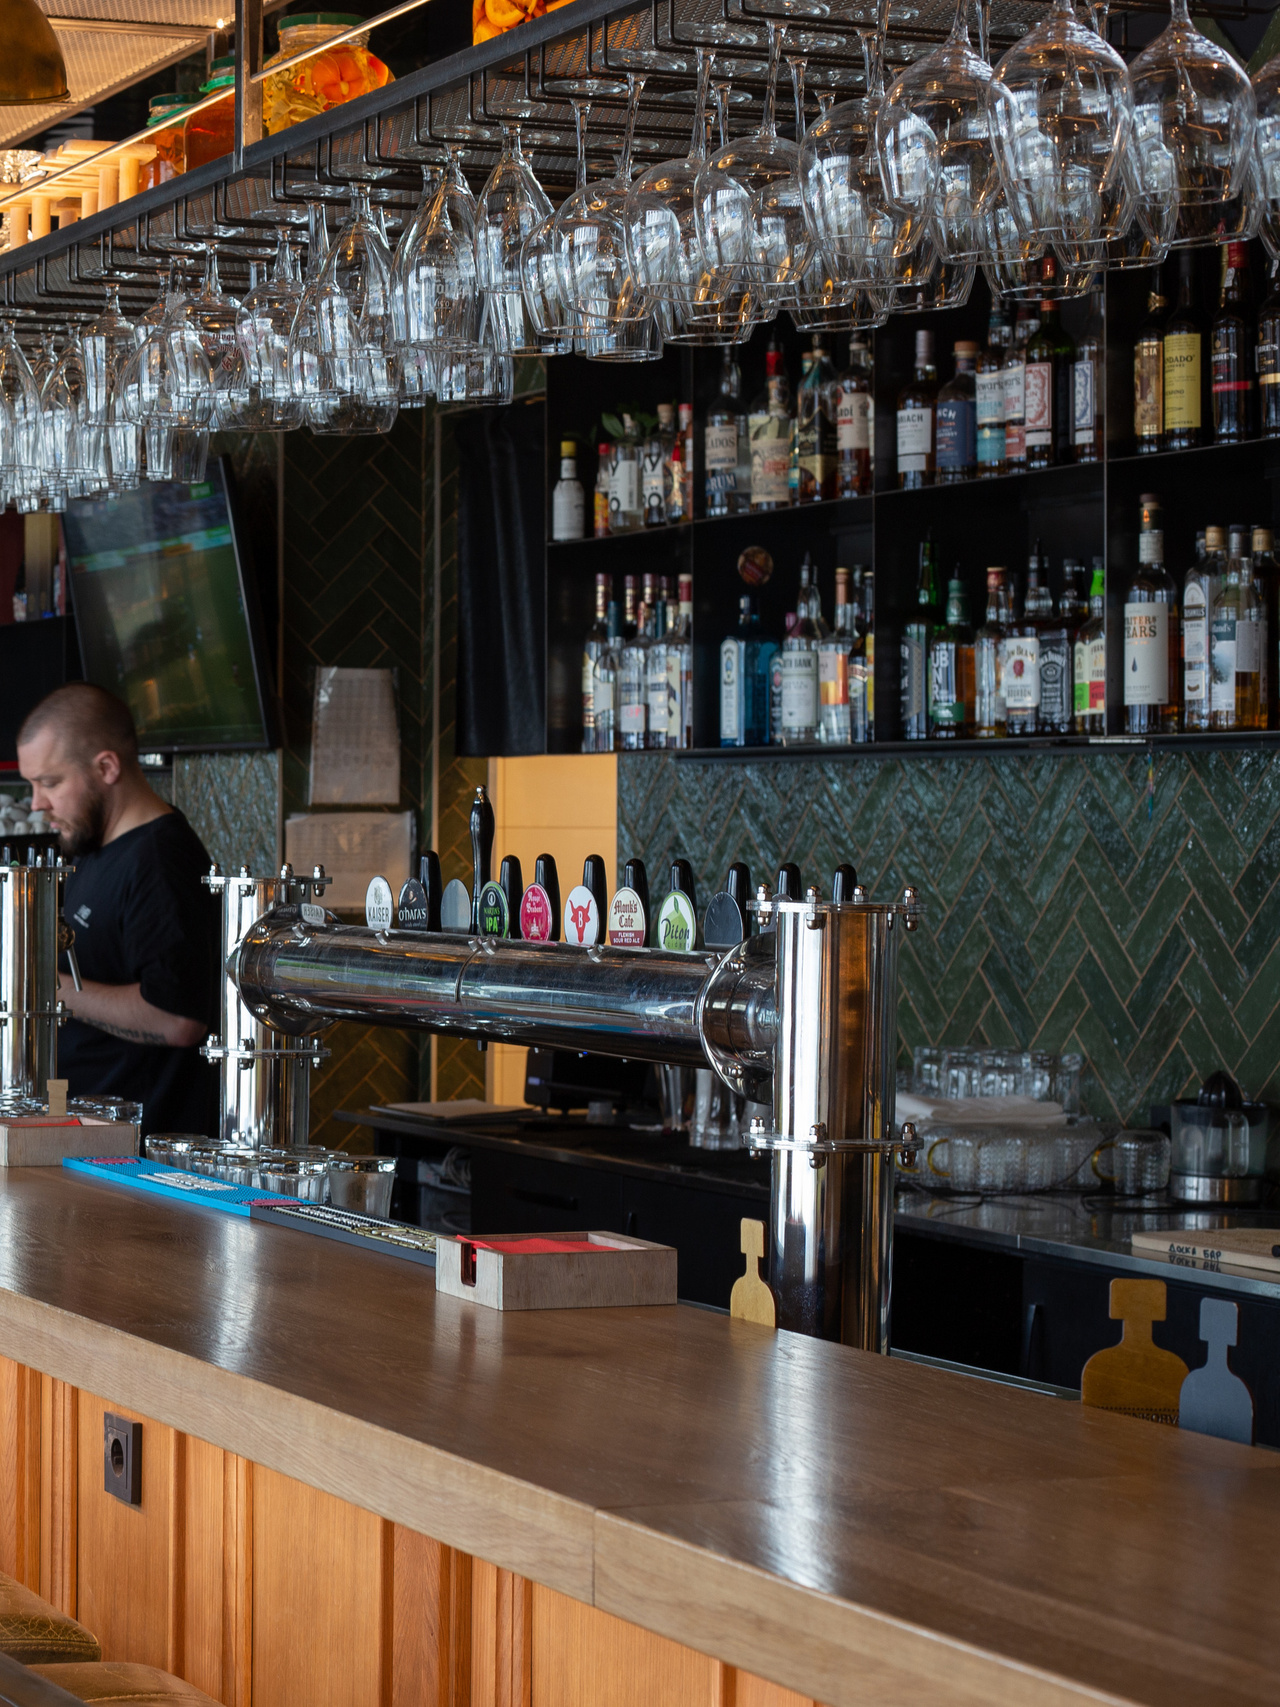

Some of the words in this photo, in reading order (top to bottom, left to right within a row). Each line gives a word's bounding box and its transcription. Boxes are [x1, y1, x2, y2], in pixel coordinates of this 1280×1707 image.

[368, 906, 389, 923] KAISER
[578, 911, 583, 928] B
[486, 917, 498, 933] IPA
[660, 918, 690, 944] Piton
